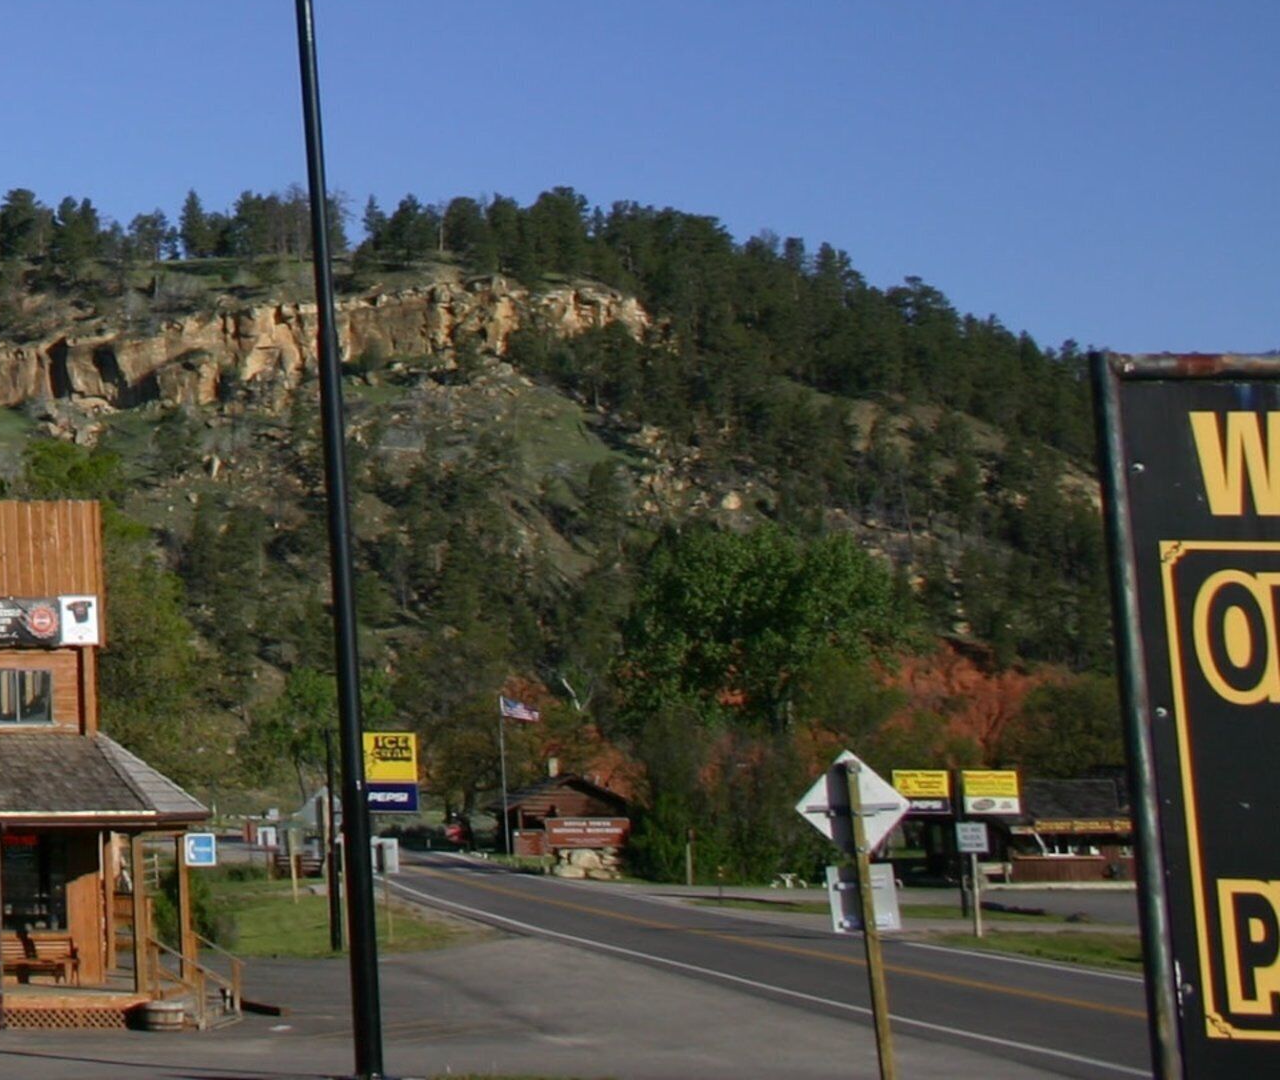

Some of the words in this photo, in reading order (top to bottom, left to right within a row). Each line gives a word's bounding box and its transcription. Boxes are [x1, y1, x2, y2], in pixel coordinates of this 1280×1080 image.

[1193, 569, 1280, 705] O
[373, 735, 409, 749] ICE
[373, 747, 412, 762] CREAM
[367, 791, 409, 802] PEPSI
